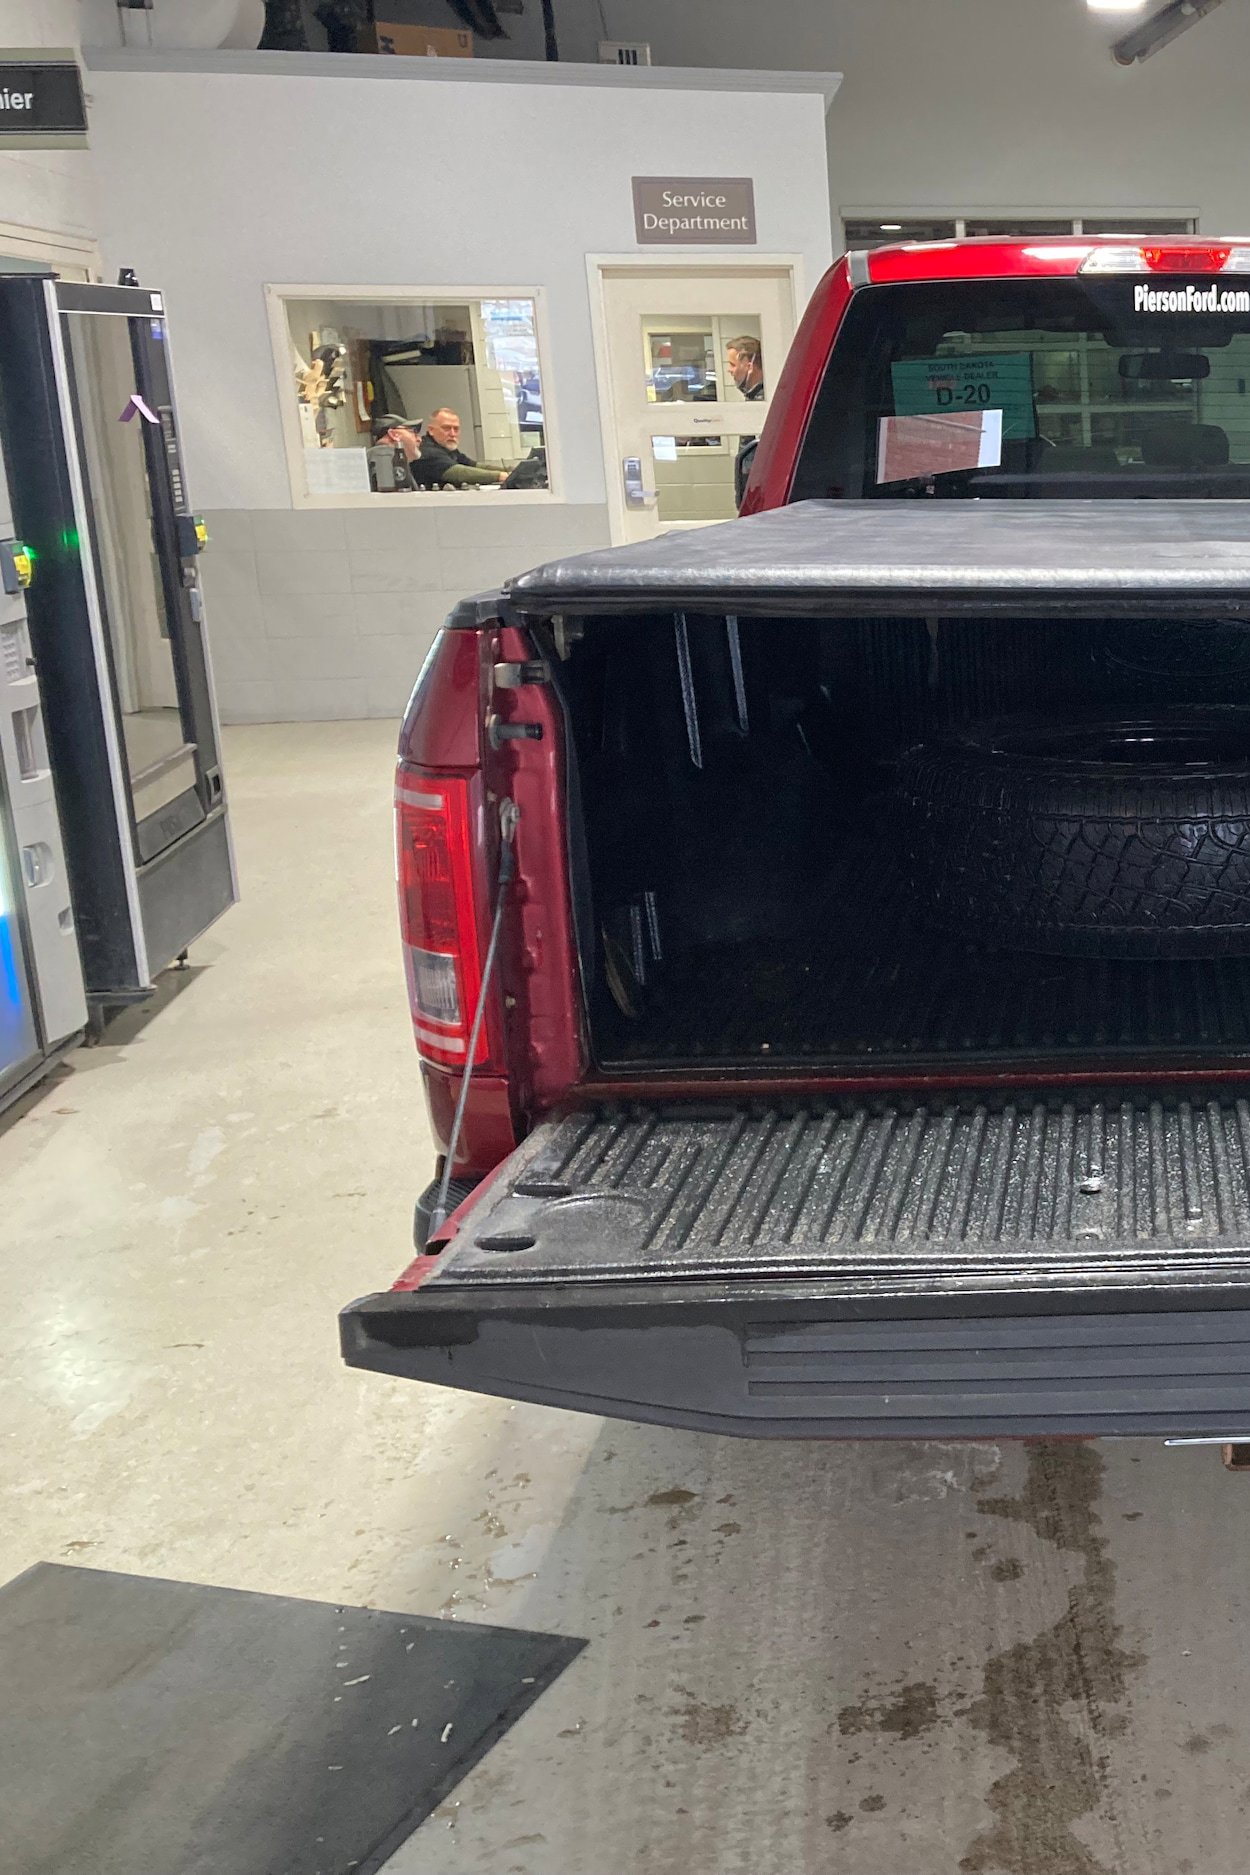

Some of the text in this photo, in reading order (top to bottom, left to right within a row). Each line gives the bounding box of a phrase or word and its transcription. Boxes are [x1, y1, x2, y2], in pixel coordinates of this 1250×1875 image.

[662, 190, 727, 208] Service
[643, 213, 749, 235] Department
[1134, 284, 1250, 313] PiersonFord.com
[936, 383, 992, 406] D-20
